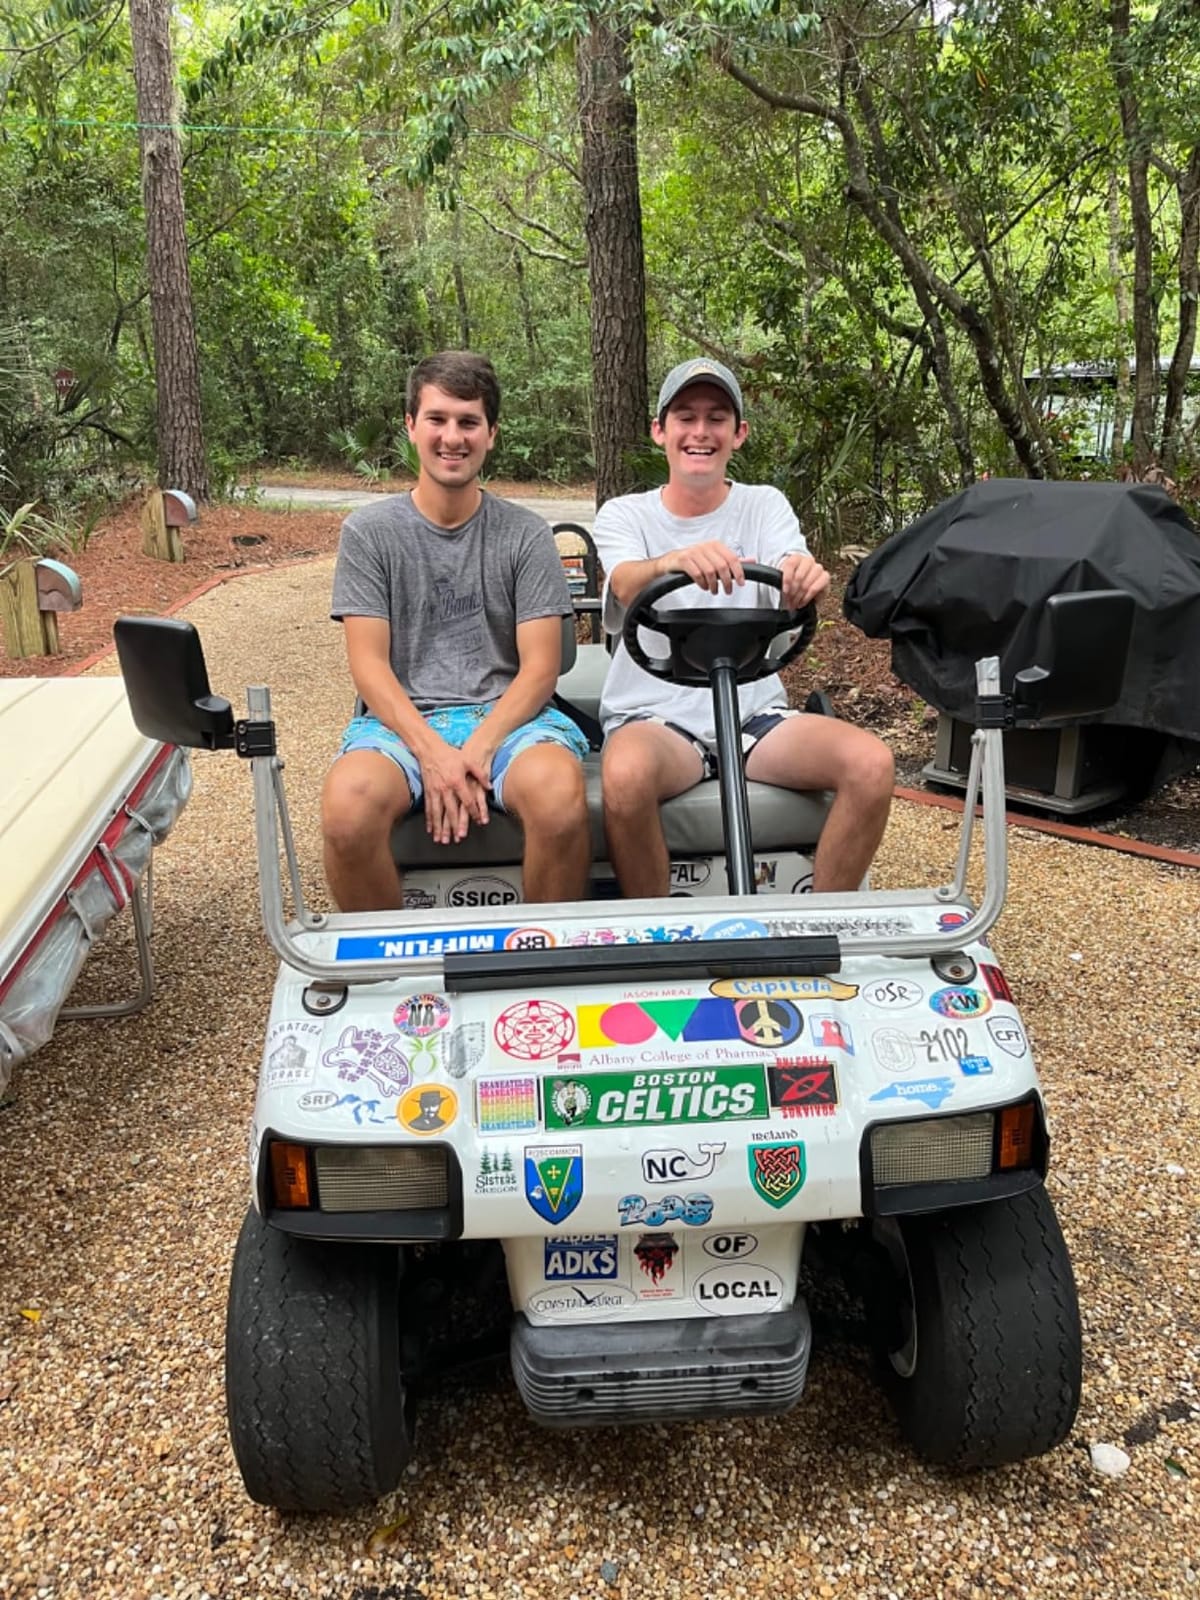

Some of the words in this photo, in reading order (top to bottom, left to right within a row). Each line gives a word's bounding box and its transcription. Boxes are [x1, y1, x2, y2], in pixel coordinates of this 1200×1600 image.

[452, 891, 515, 906] SSICP
[623, 990, 659, 999] JASON
[661, 988, 693, 997] MRAZ
[733, 979, 832, 995] Capitola
[589, 1054, 636, 1067] Albany
[641, 1050, 690, 1065] College
[696, 1049, 711, 1060] of
[717, 1048, 778, 1060] Pharmacy
[633, 1071, 716, 1088] BOSTON
[894, 1082, 942, 1096] home.
[596, 1083, 756, 1122] CELTICS
[647, 1156, 688, 1179] NC
[713, 1236, 748, 1253] OF
[546, 1246, 616, 1276] ADKS
[700, 1280, 778, 1300] LOCAL
